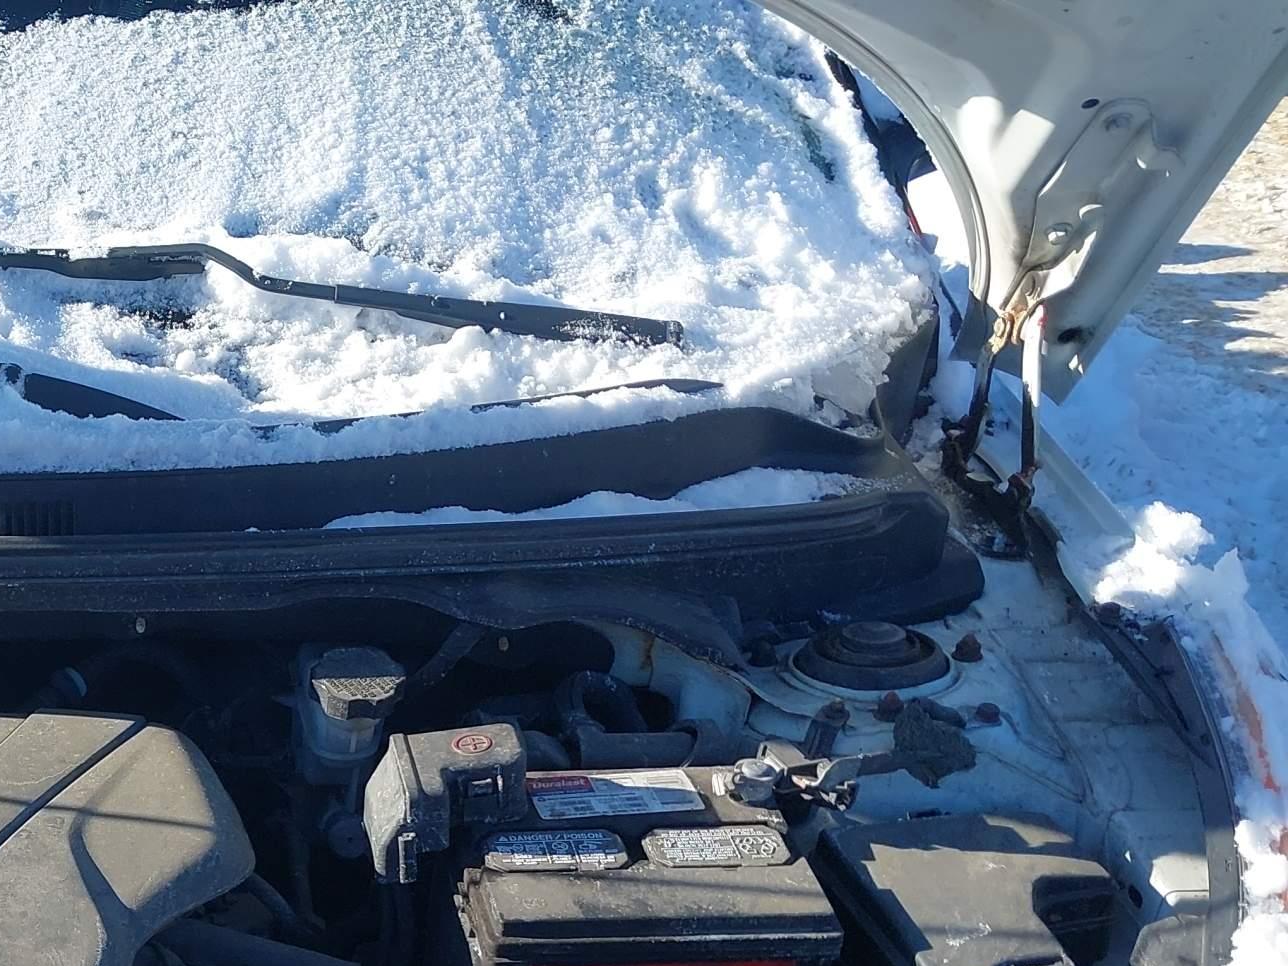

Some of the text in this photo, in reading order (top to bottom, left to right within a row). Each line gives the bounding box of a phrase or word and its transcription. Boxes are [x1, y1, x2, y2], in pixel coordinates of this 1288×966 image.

[532, 778, 586, 790] Duralast
[509, 833, 553, 842] DANGER
[563, 832, 604, 841] POISON
